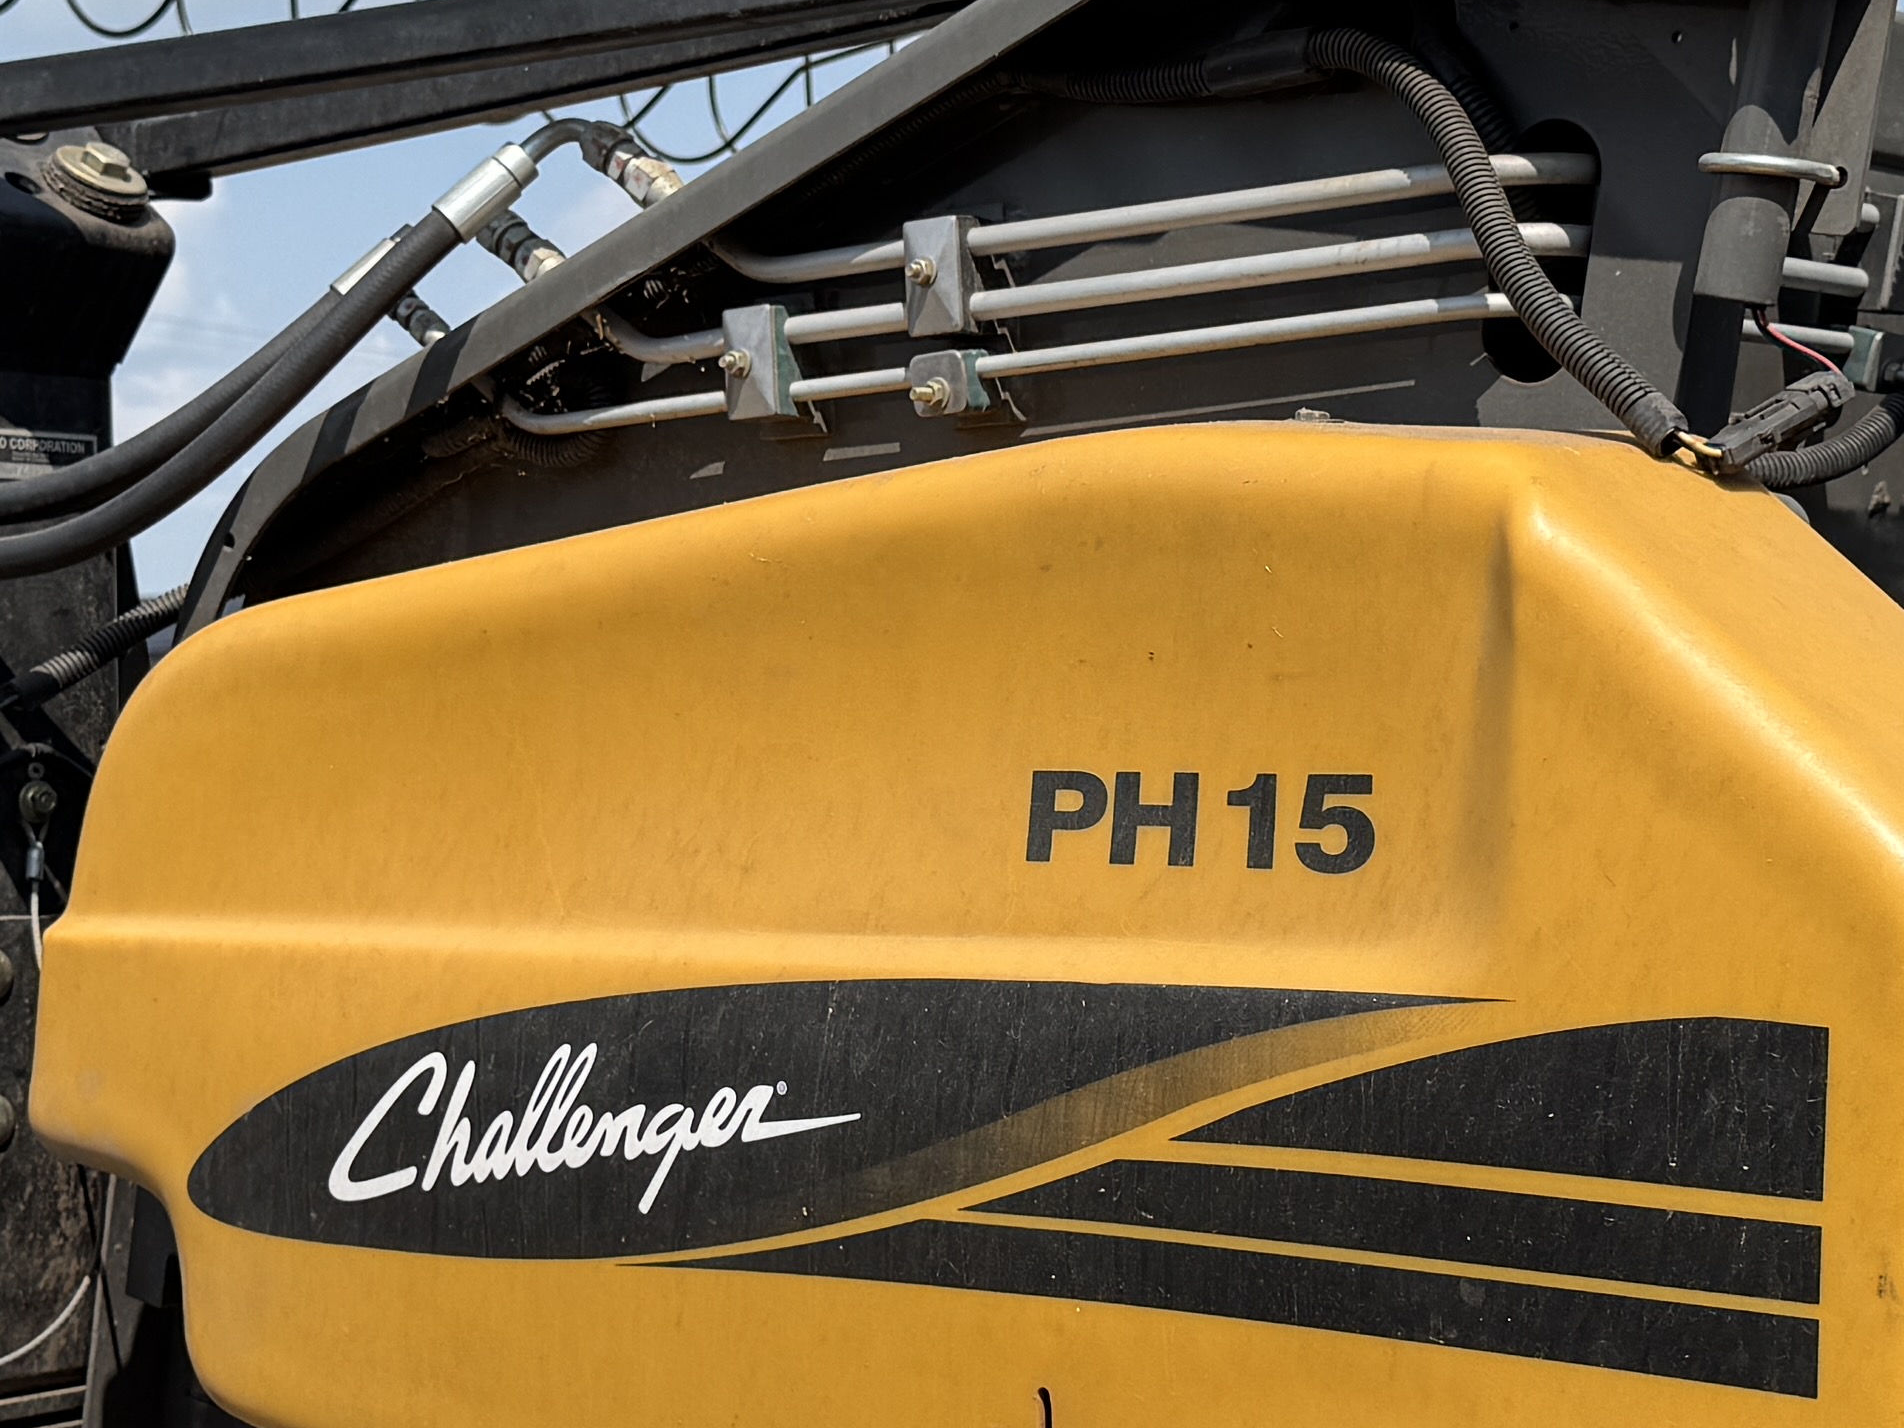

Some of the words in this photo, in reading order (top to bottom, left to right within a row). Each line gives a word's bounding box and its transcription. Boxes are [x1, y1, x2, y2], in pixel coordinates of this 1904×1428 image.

[9, 437, 86, 454] CORPORATION
[1026, 770, 1200, 867] PH
[1227, 773, 1376, 875] 15
[327, 1042, 862, 1215] Challenger
